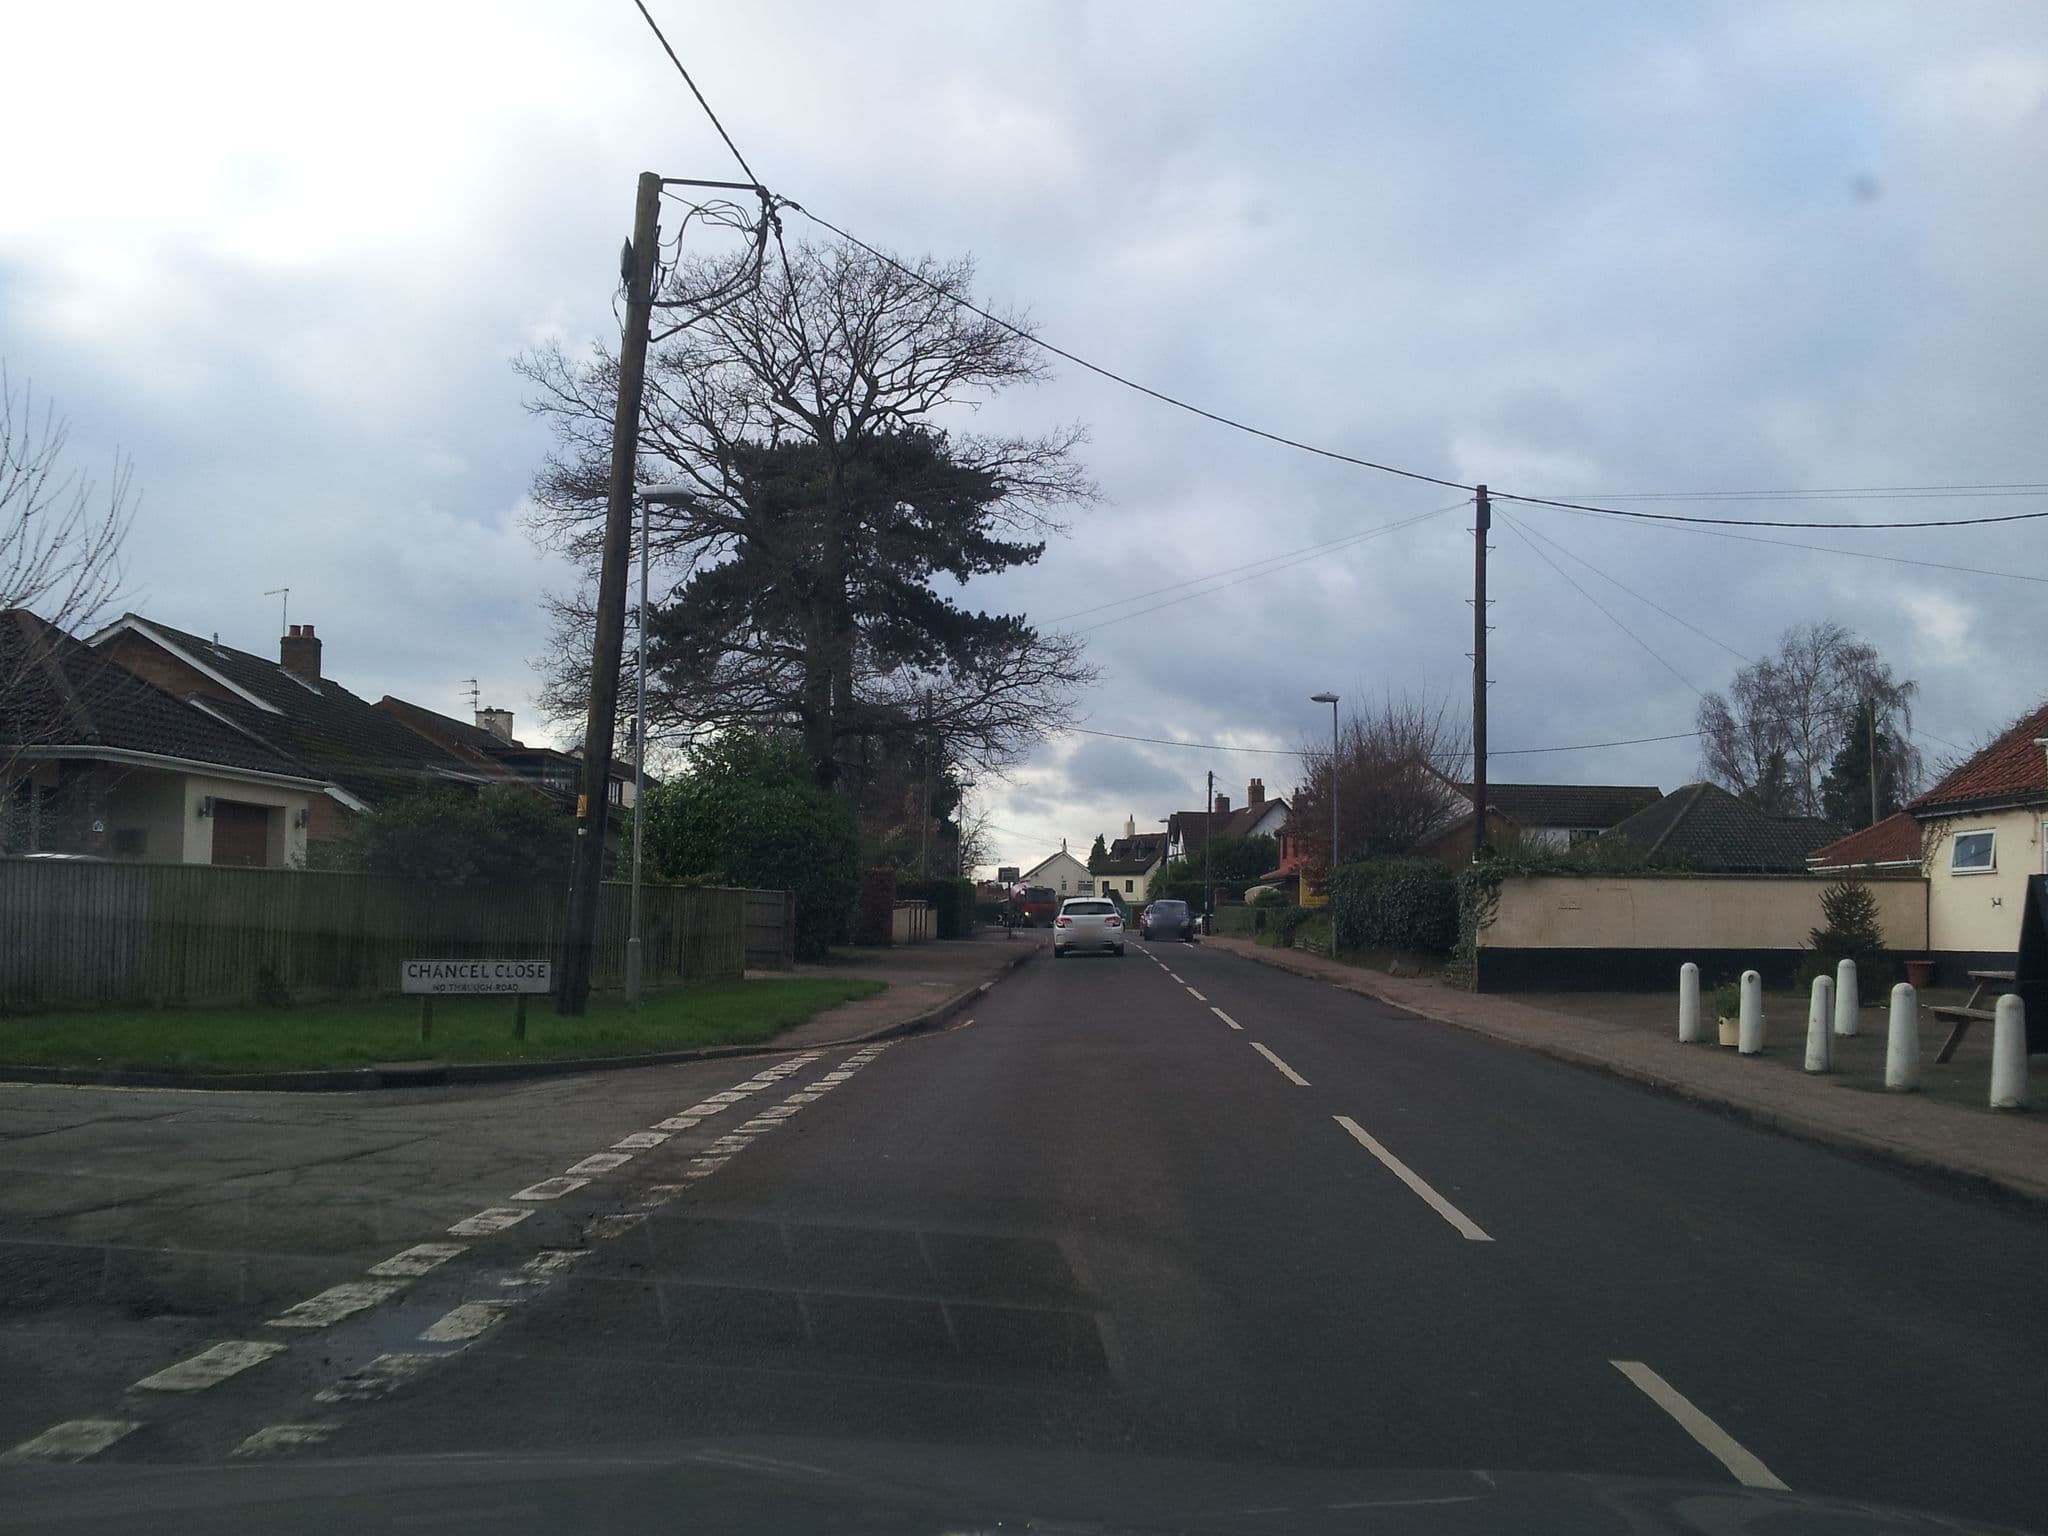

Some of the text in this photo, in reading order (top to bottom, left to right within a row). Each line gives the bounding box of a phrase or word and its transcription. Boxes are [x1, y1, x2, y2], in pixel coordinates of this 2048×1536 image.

[408, 964, 546, 978] CHANCEL CLOSE
[433, 984, 445, 992] NO
[496, 984, 519, 992] ROAD
